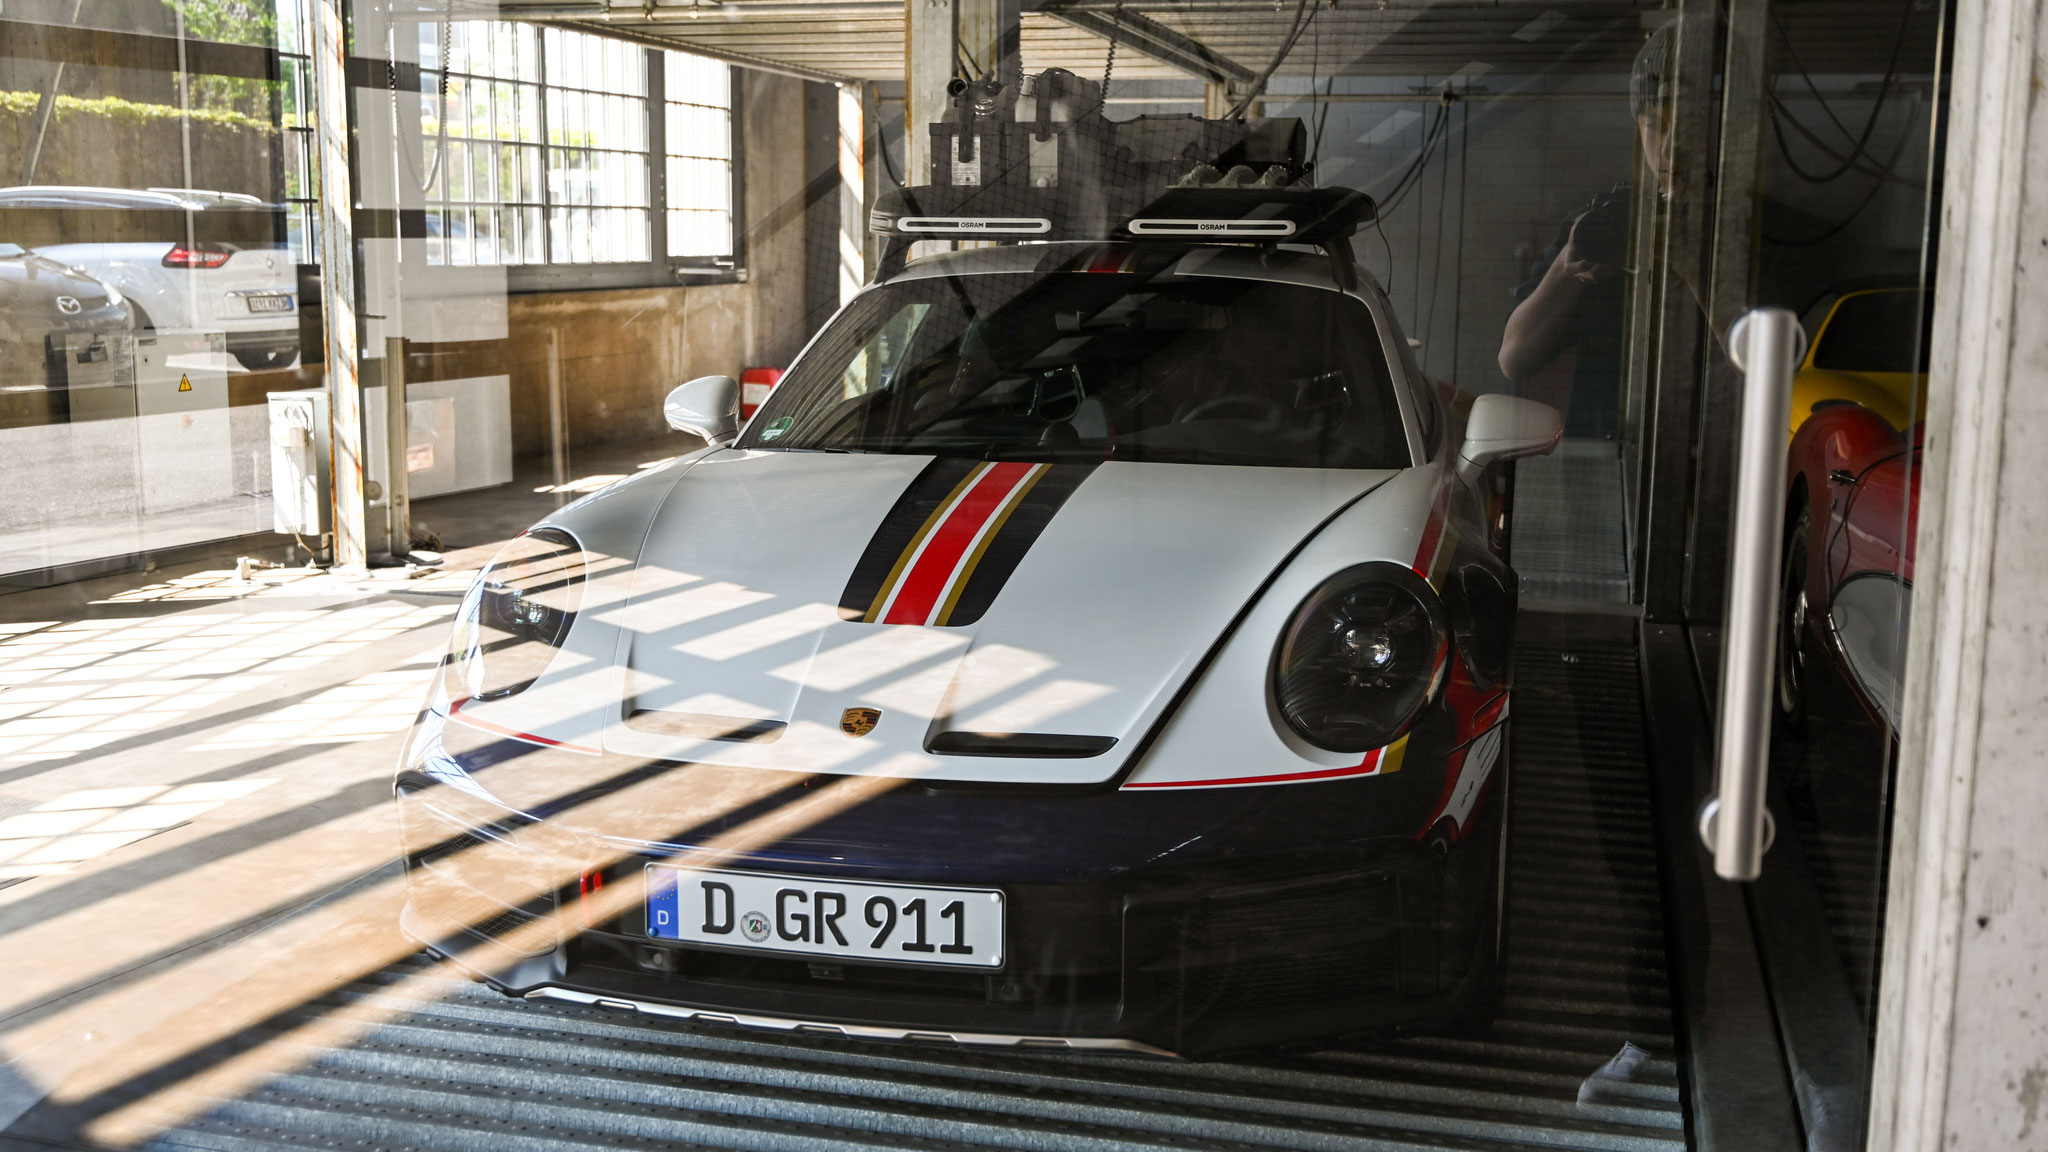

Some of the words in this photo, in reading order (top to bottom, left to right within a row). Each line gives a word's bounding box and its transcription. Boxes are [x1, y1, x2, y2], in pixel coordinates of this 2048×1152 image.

[658, 910, 669, 925] D
[701, 880, 735, 934] D
[775, 888, 849, 946] GR
[864, 895, 973, 955] 911
